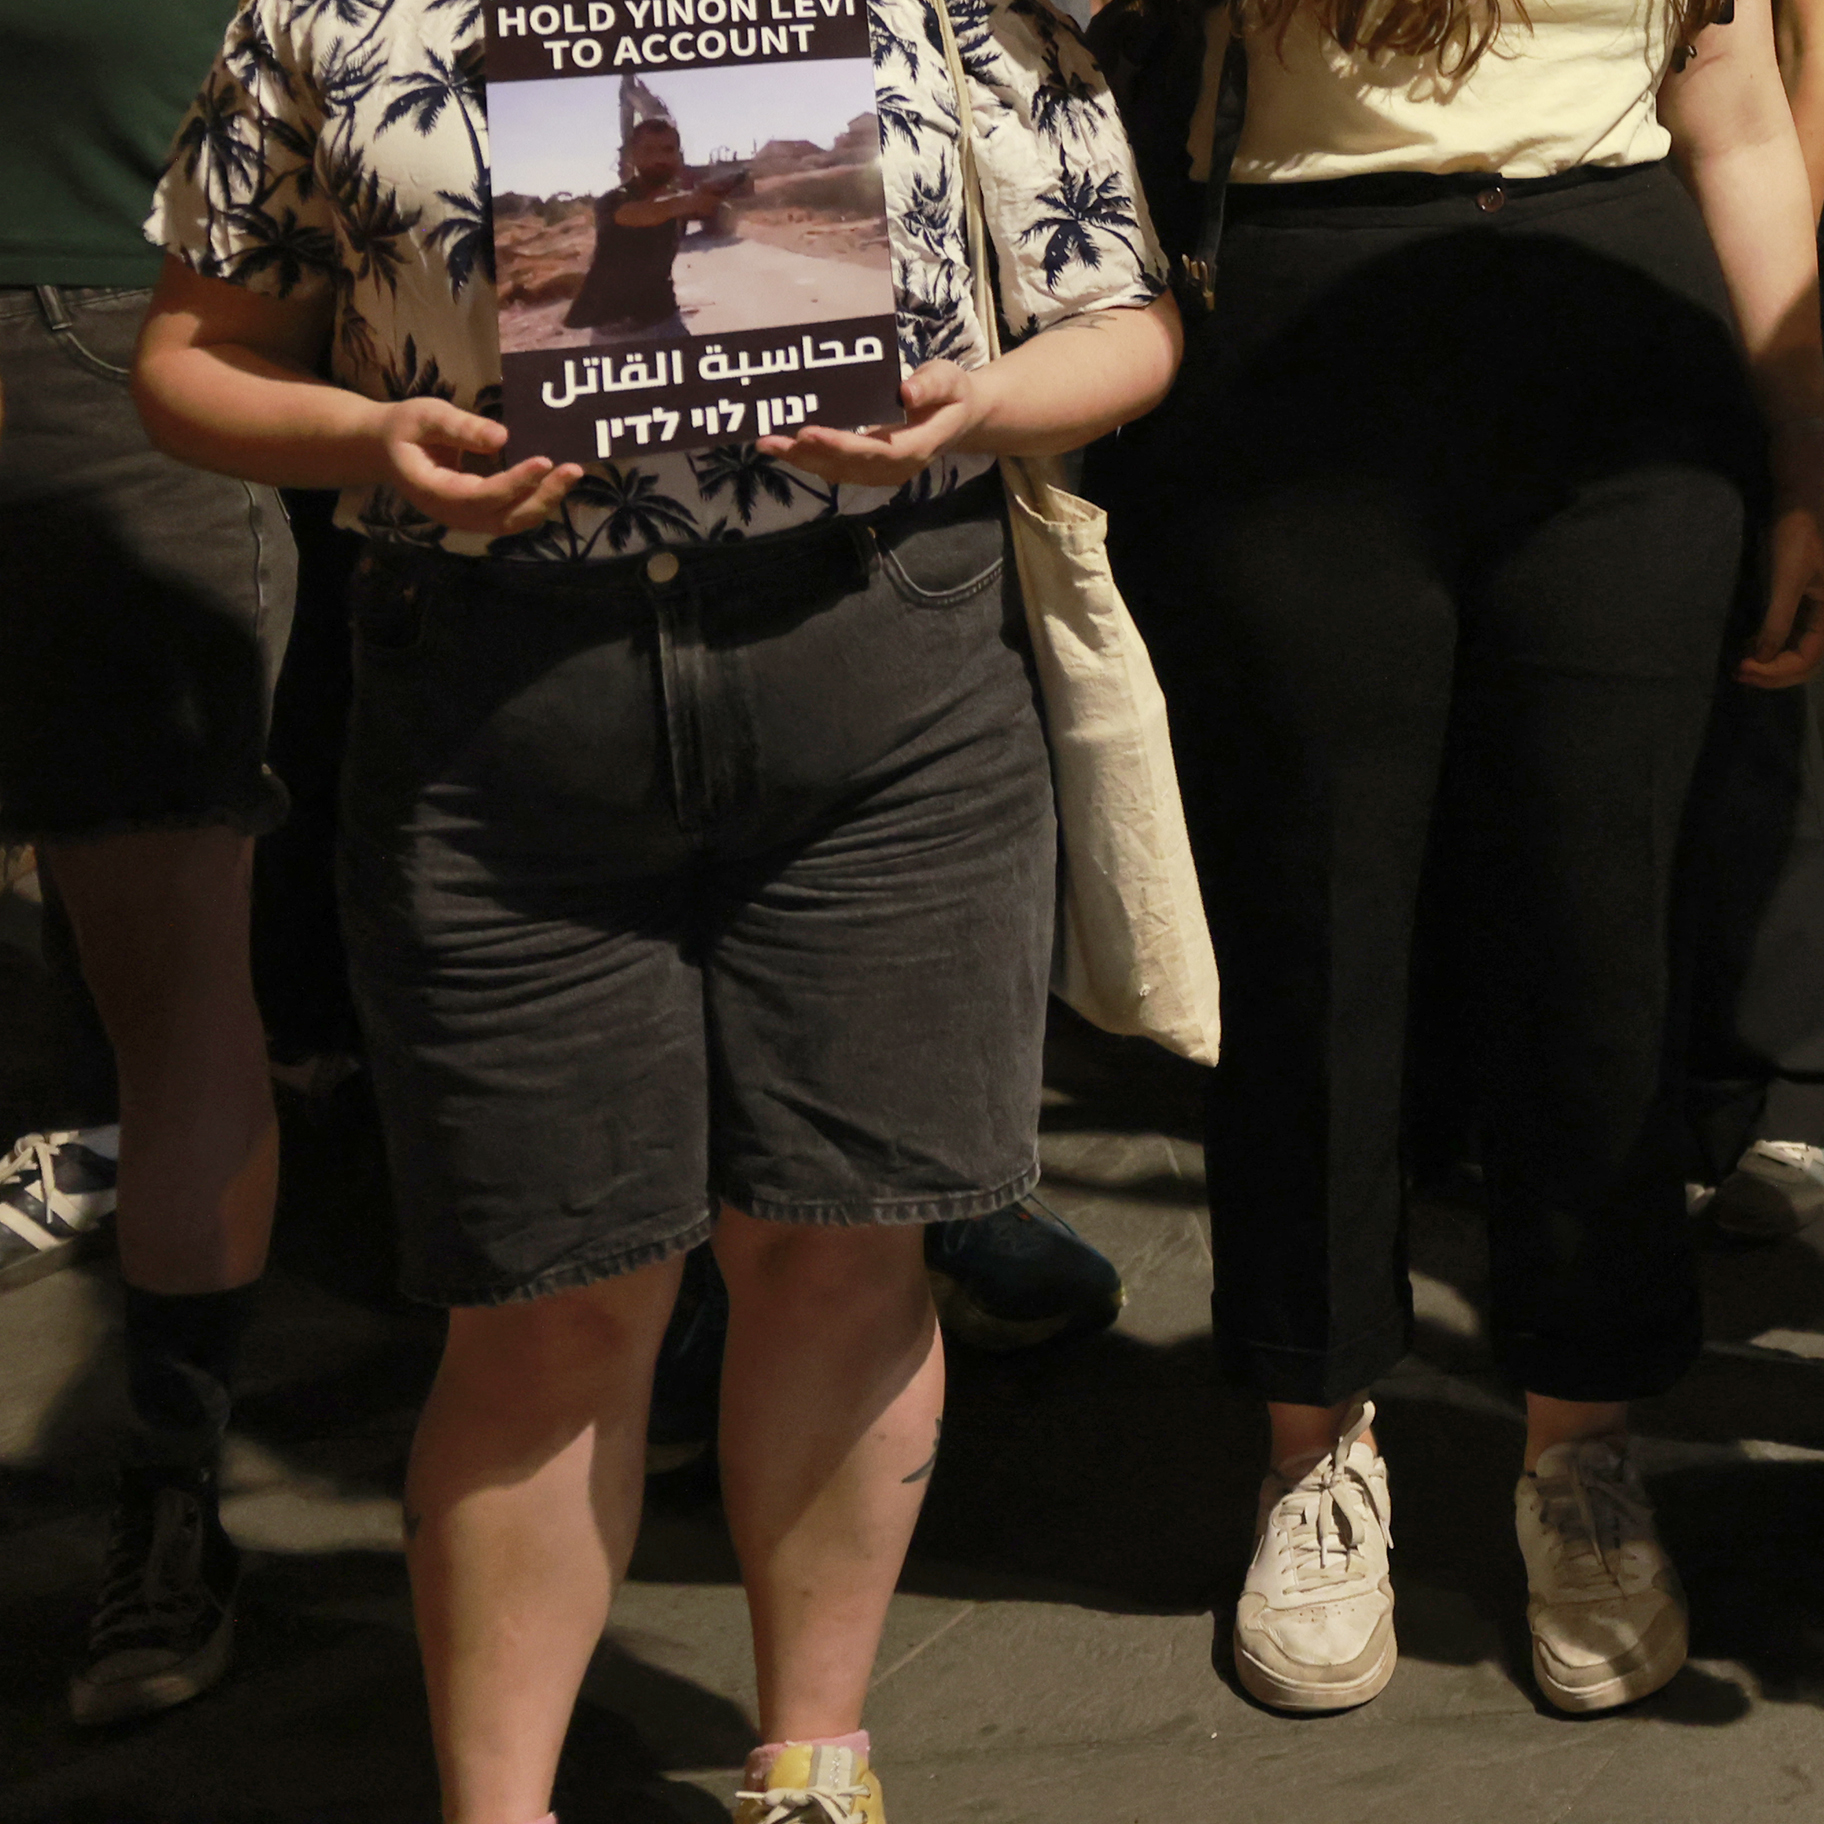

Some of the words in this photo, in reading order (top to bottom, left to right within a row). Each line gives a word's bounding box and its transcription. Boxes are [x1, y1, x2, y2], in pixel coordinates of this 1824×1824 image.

[497, 1, 616, 38] HOLD
[543, 38, 602, 71] TO
[613, 23, 816, 67] ACCOUNT
[541, 347, 684, 410] القاتل
[698, 334, 885, 386] محاسبة
[595, 406, 681, 459] לדין
[691, 398, 746, 436] לוי
[756, 392, 819, 437] ינון
